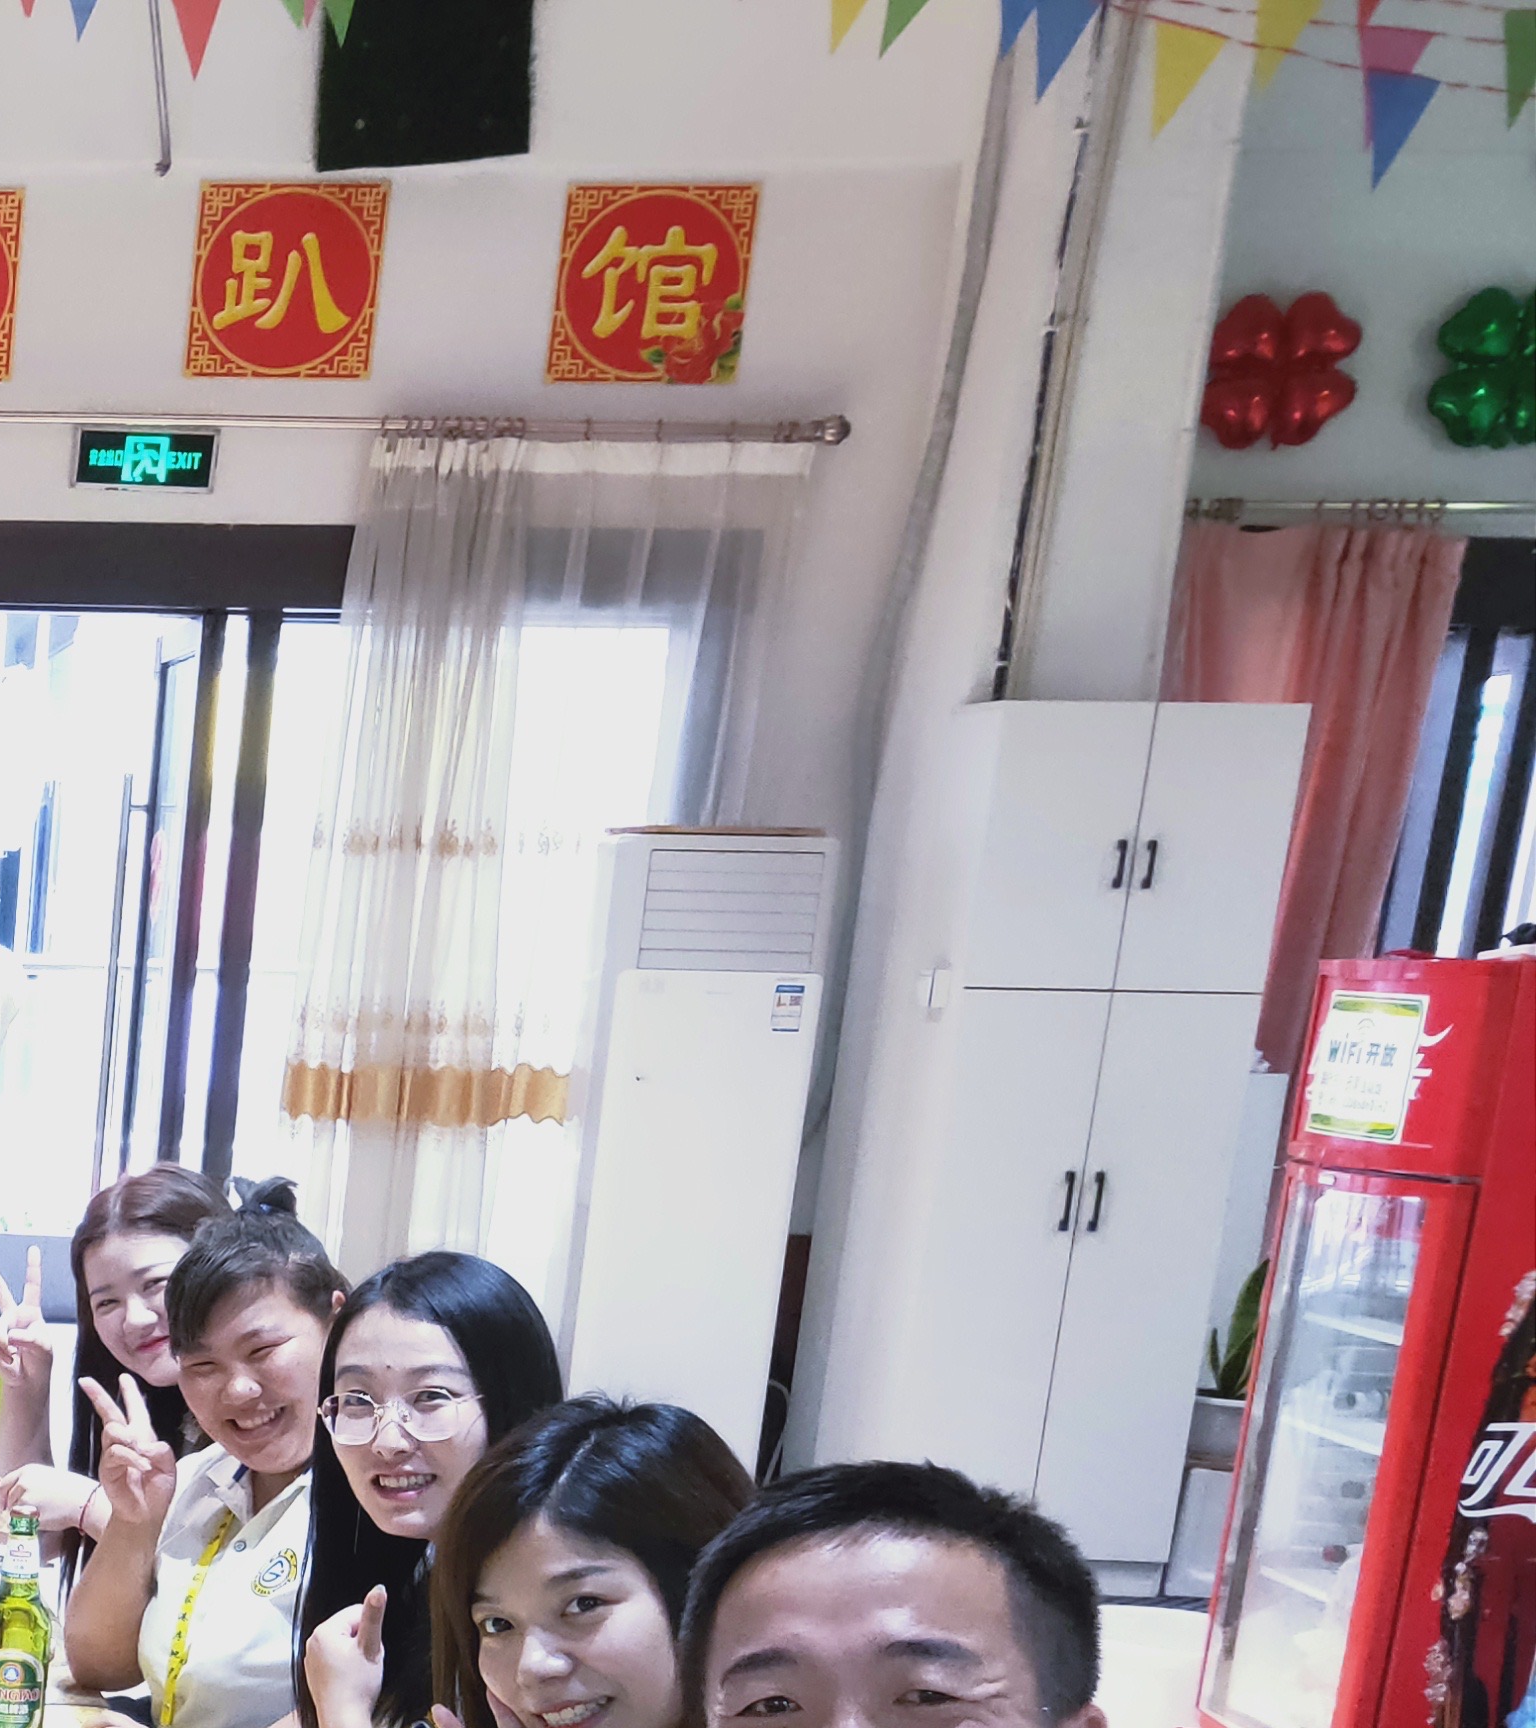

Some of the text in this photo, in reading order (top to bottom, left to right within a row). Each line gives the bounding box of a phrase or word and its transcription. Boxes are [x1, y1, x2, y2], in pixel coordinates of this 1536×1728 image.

[212, 230, 352, 334] 趴
[582, 225, 718, 340] 馆
[167, 451, 202, 470] EXIT
